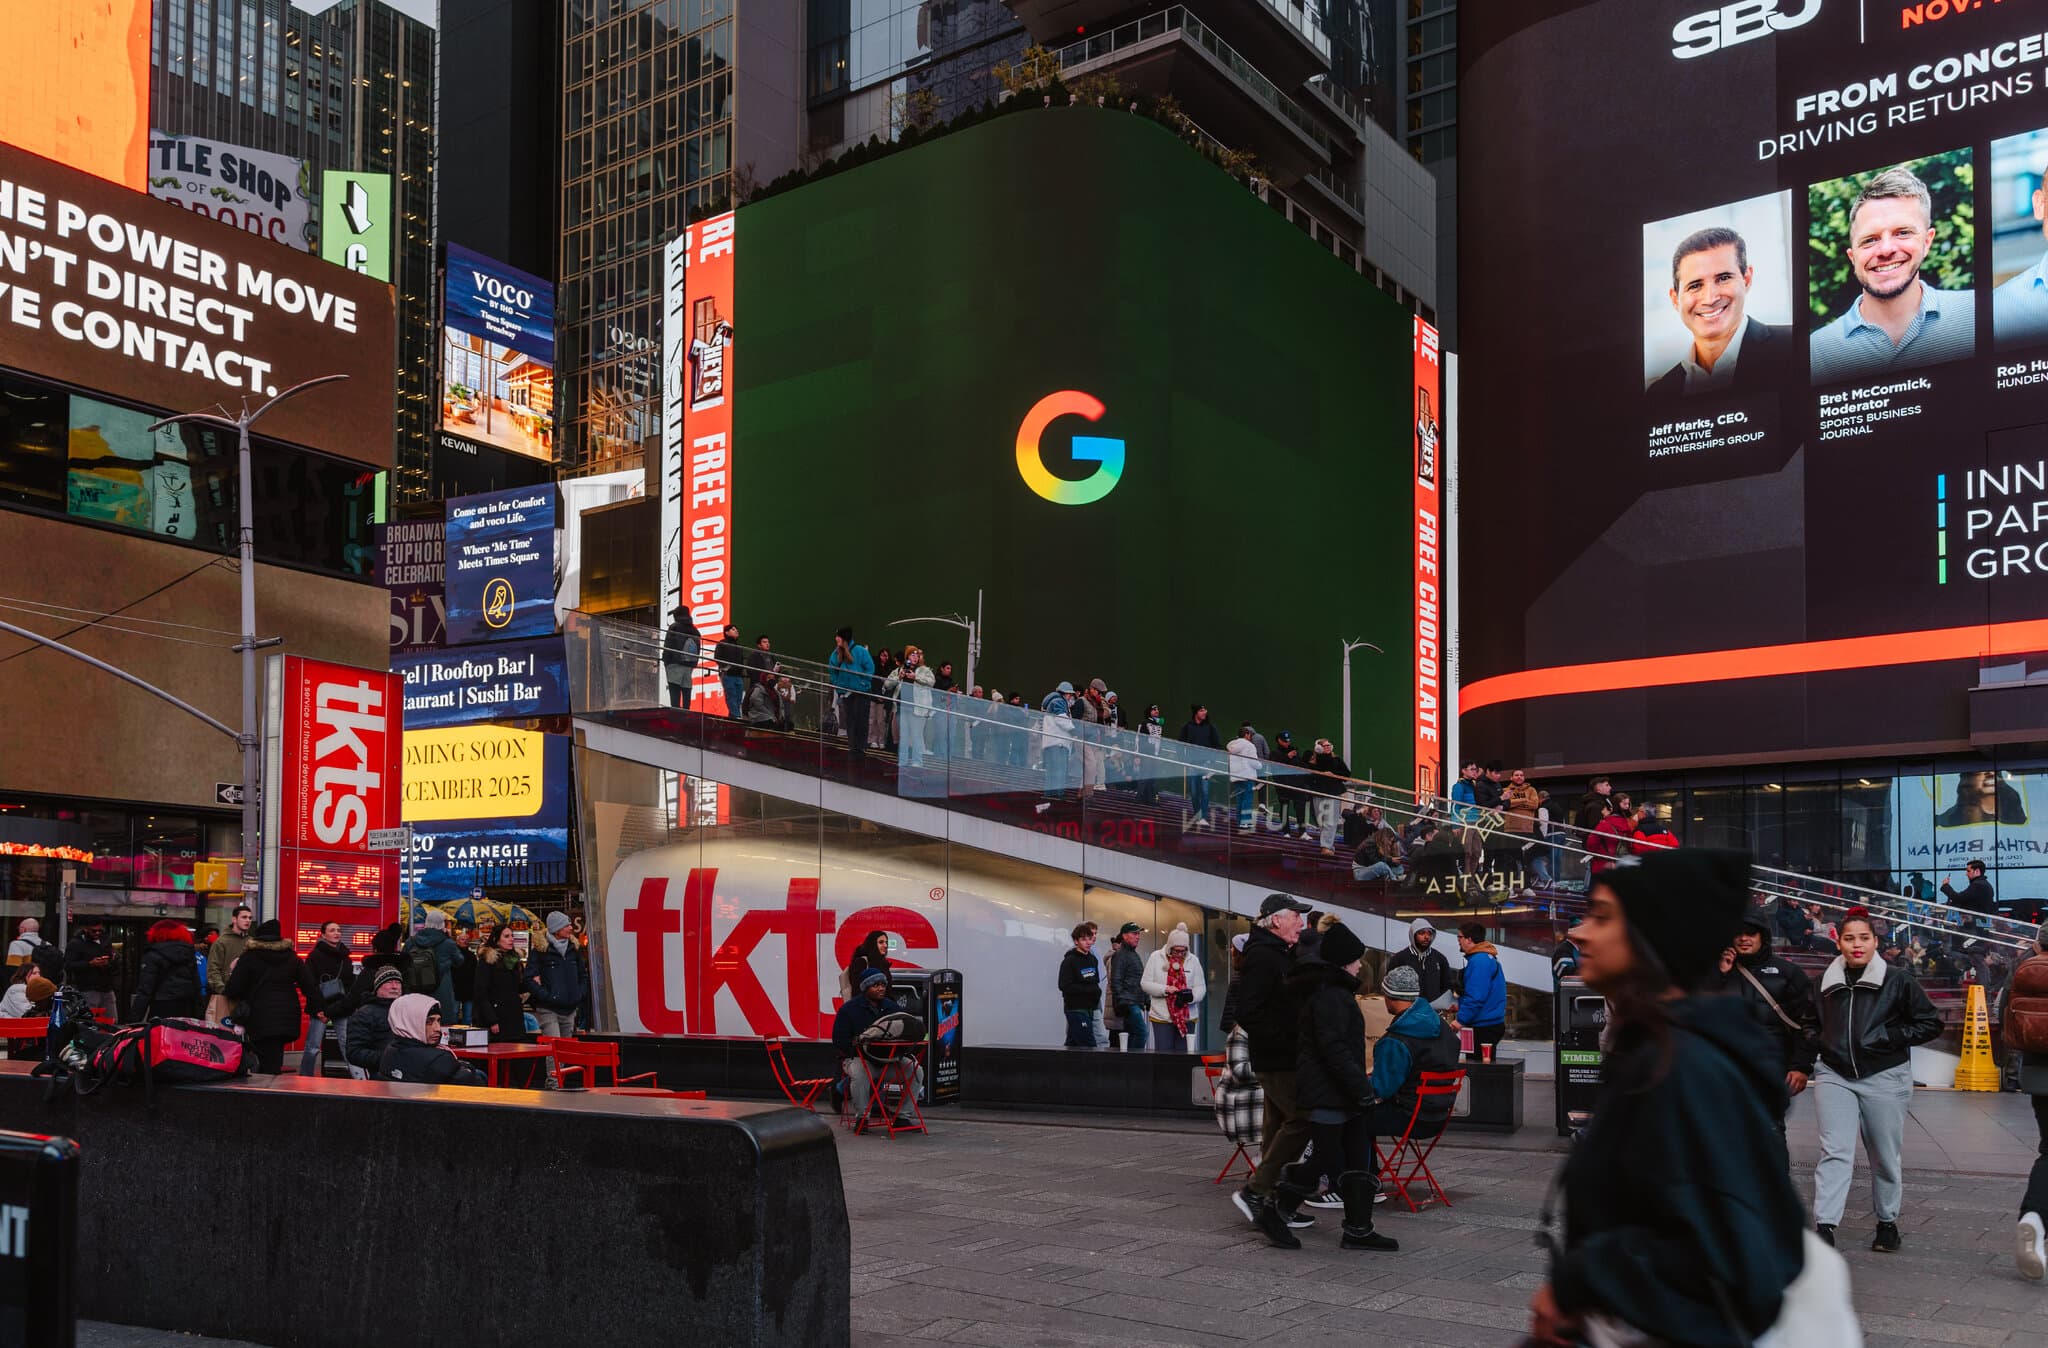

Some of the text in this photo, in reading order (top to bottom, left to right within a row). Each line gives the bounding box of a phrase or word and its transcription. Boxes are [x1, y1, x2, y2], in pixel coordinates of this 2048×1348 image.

[1902, 0, 1982, 29] NOV.
[1672, 0, 1822, 60] SBJ
[1796, 32, 2048, 122] FROM CONCE
[1758, 72, 2033, 161] DRIVING RETURNS
[150, 139, 292, 212] TLE SHOP
[186, 181, 207, 195] OF
[699, 212, 735, 264] RE
[57, 200, 228, 291] POWER
[237, 263, 357, 334] MOVE
[87, 259, 254, 343] DIRECT
[472, 270, 532, 310] VOCO
[489, 299, 499, 309] BY
[480, 309, 522, 332] Times Square
[51, 301, 278, 398] CONTACT.
[1421, 317, 1439, 367] RE
[1997, 363, 2027, 378] Rob
[1997, 372, 2048, 389] HUNDEN
[1820, 377, 1932, 405] Bret McCormick,
[1820, 398, 1890, 418] Moderator
[1820, 405, 1922, 430] SPORTS BUSINESS
[1649, 411, 1748, 437] Jeff Marks, CEO,
[1820, 425, 1874, 441] JOURNAL
[441, 436, 477, 455] KEVANI
[1016, 389, 1126, 505] G
[1649, 429, 1712, 448] INNOVATIVE
[1649, 431, 1765, 458] PARTNERSHIPS GROUP
[692, 431, 726, 509] FREE
[1967, 460, 2045, 500] INN
[453, 496, 546, 518] Come on in for Comfort
[469, 512, 526, 529] and voco Life.
[458, 551, 539, 570] Meets Times Square
[463, 543, 490, 556] Where
[1418, 508, 1437, 743] FREE CHOCOLATE
[431, 657, 493, 683] Rooftop
[498, 656, 526, 676] Bar
[303, 687, 312, 718] service
[403, 681, 542, 711] taurant Sushi Bar
[303, 720, 311, 729] of
[302, 730, 311, 761] theatre
[406, 737, 528, 766] MING SOON
[312, 679, 386, 845] tkts
[225, 790, 241, 800] ONE
[300, 763, 310, 819] development
[403, 775, 531, 801] CEMBER 2025
[300, 821, 309, 841] fund
[447, 844, 528, 859] CARNEGIE
[448, 860, 482, 869] DINER
[623, 868, 939, 1040] tkts
[180, 1040, 210, 1054] NORTH
